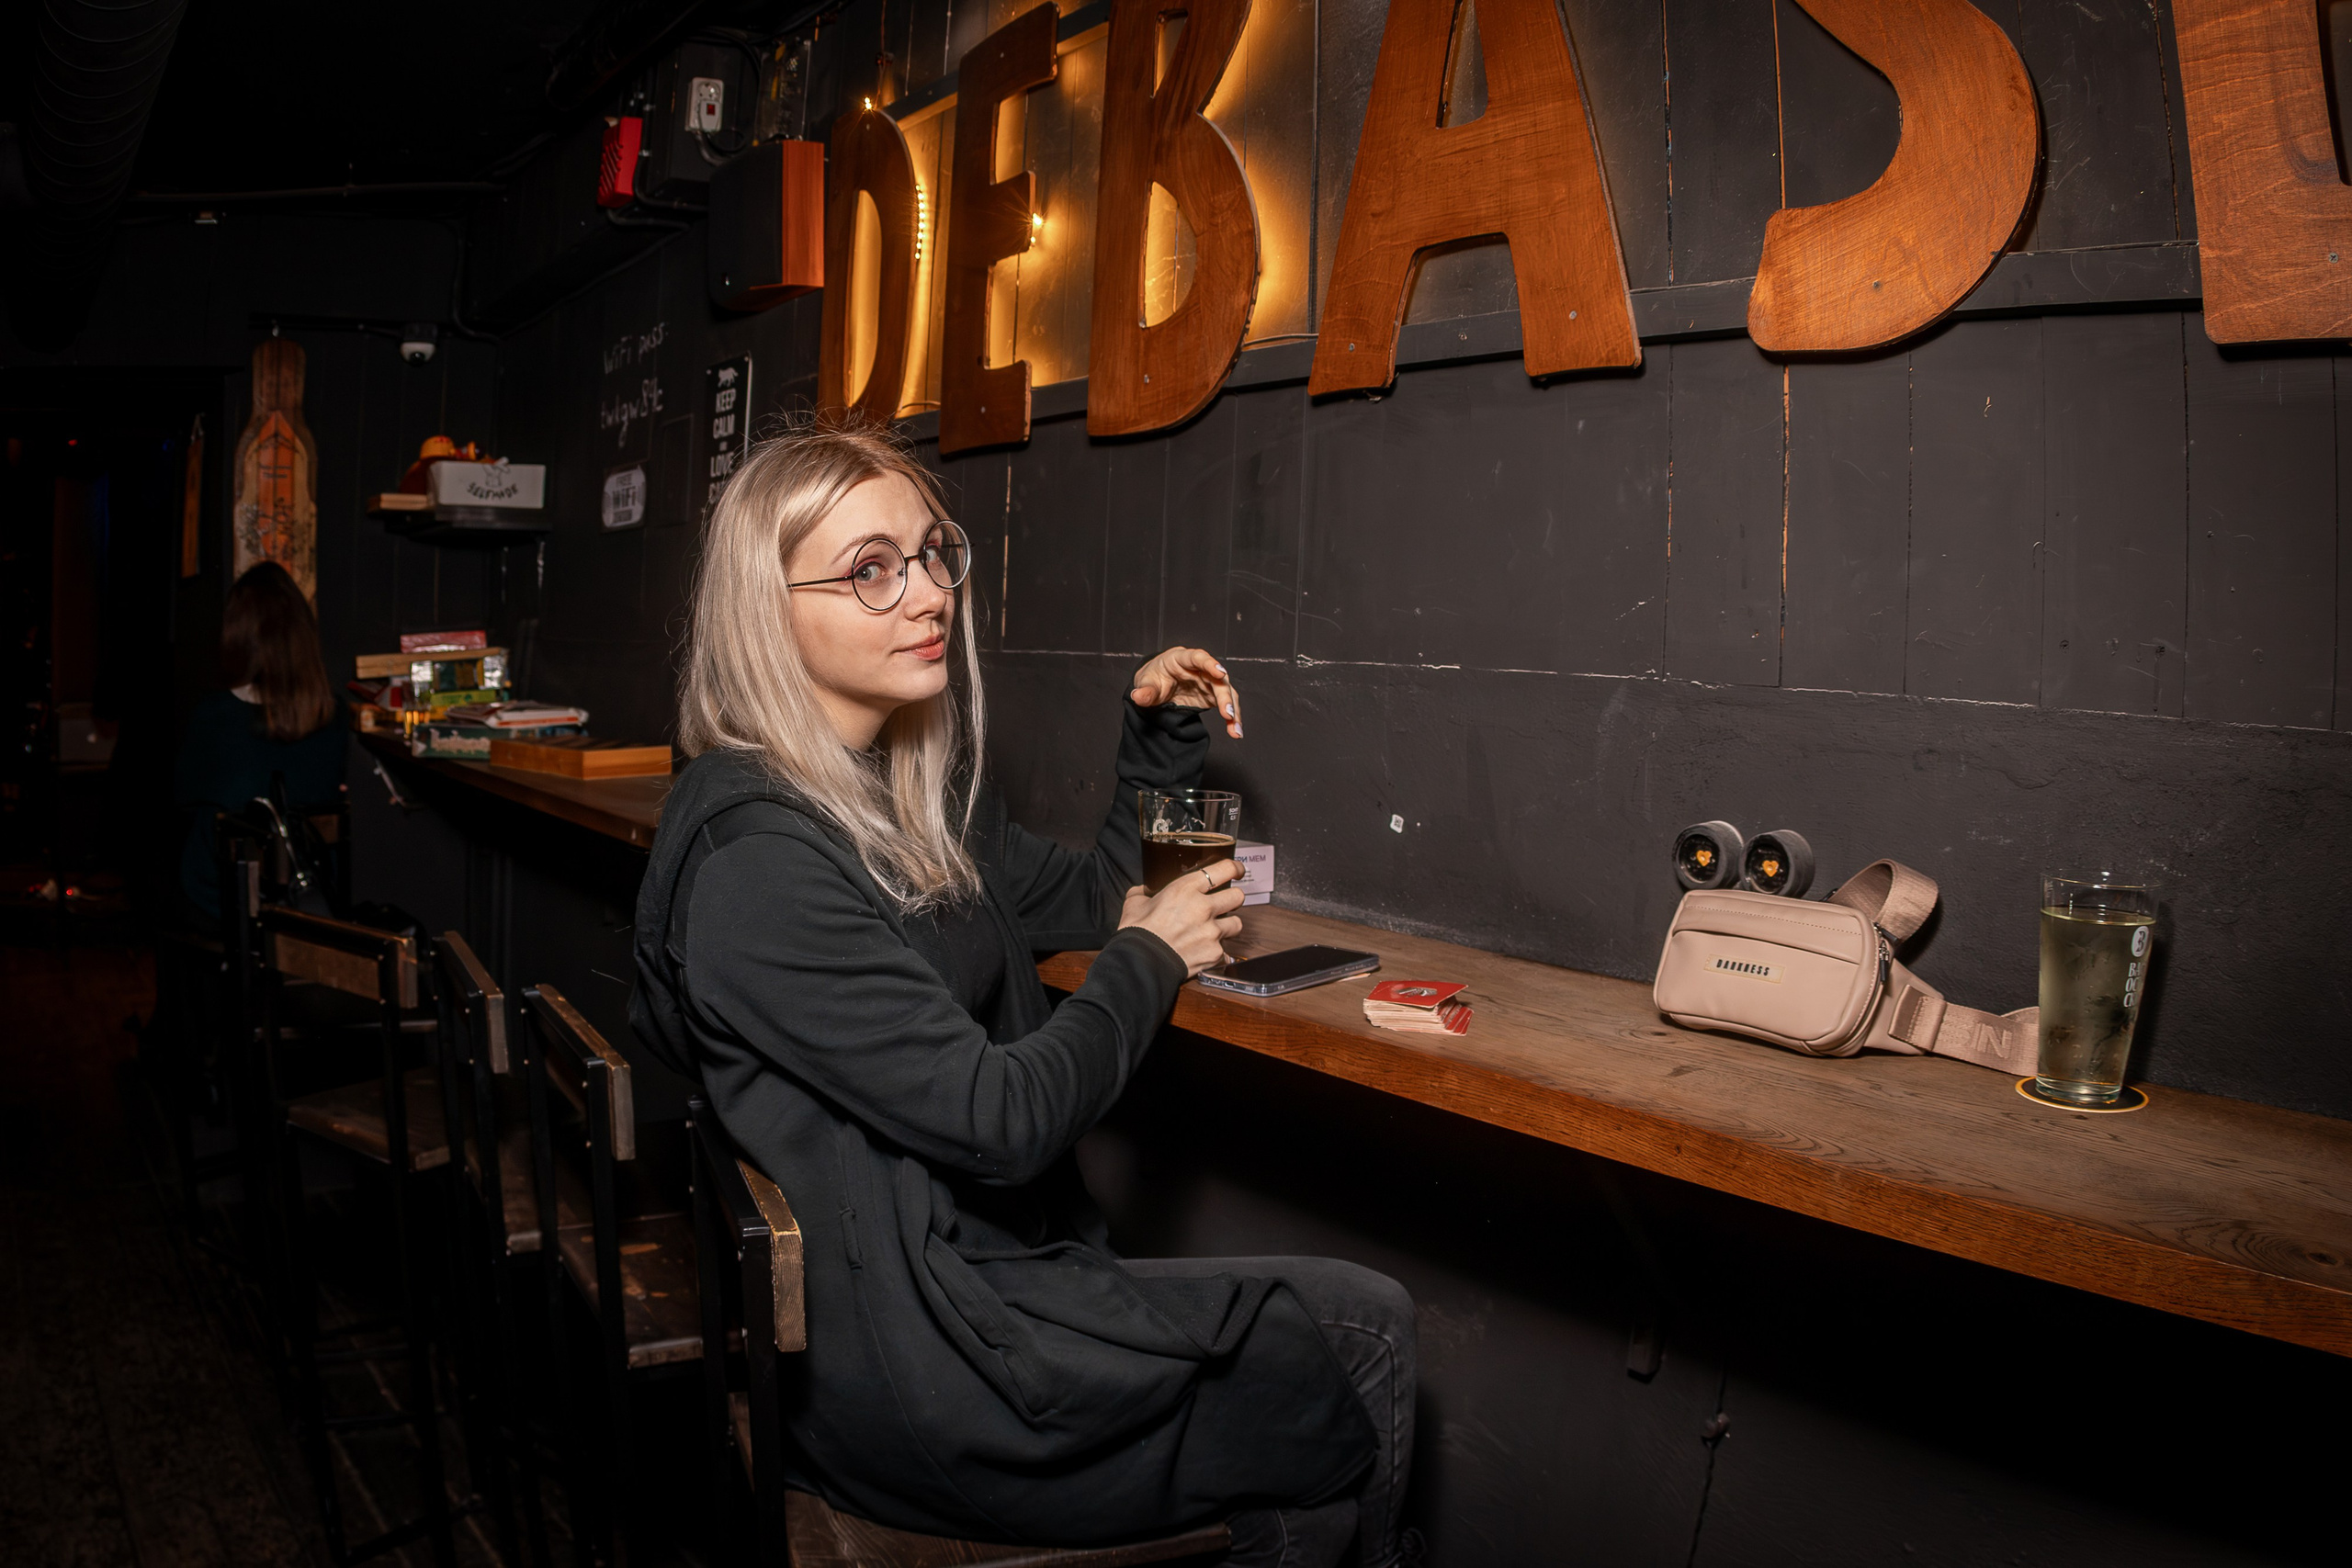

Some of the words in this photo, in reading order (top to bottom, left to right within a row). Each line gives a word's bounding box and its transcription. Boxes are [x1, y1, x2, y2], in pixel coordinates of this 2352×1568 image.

[715, 388, 737, 413] KEEP
[712, 414, 736, 440] CALM
[1716, 959, 1770, 976] DARKNESS
